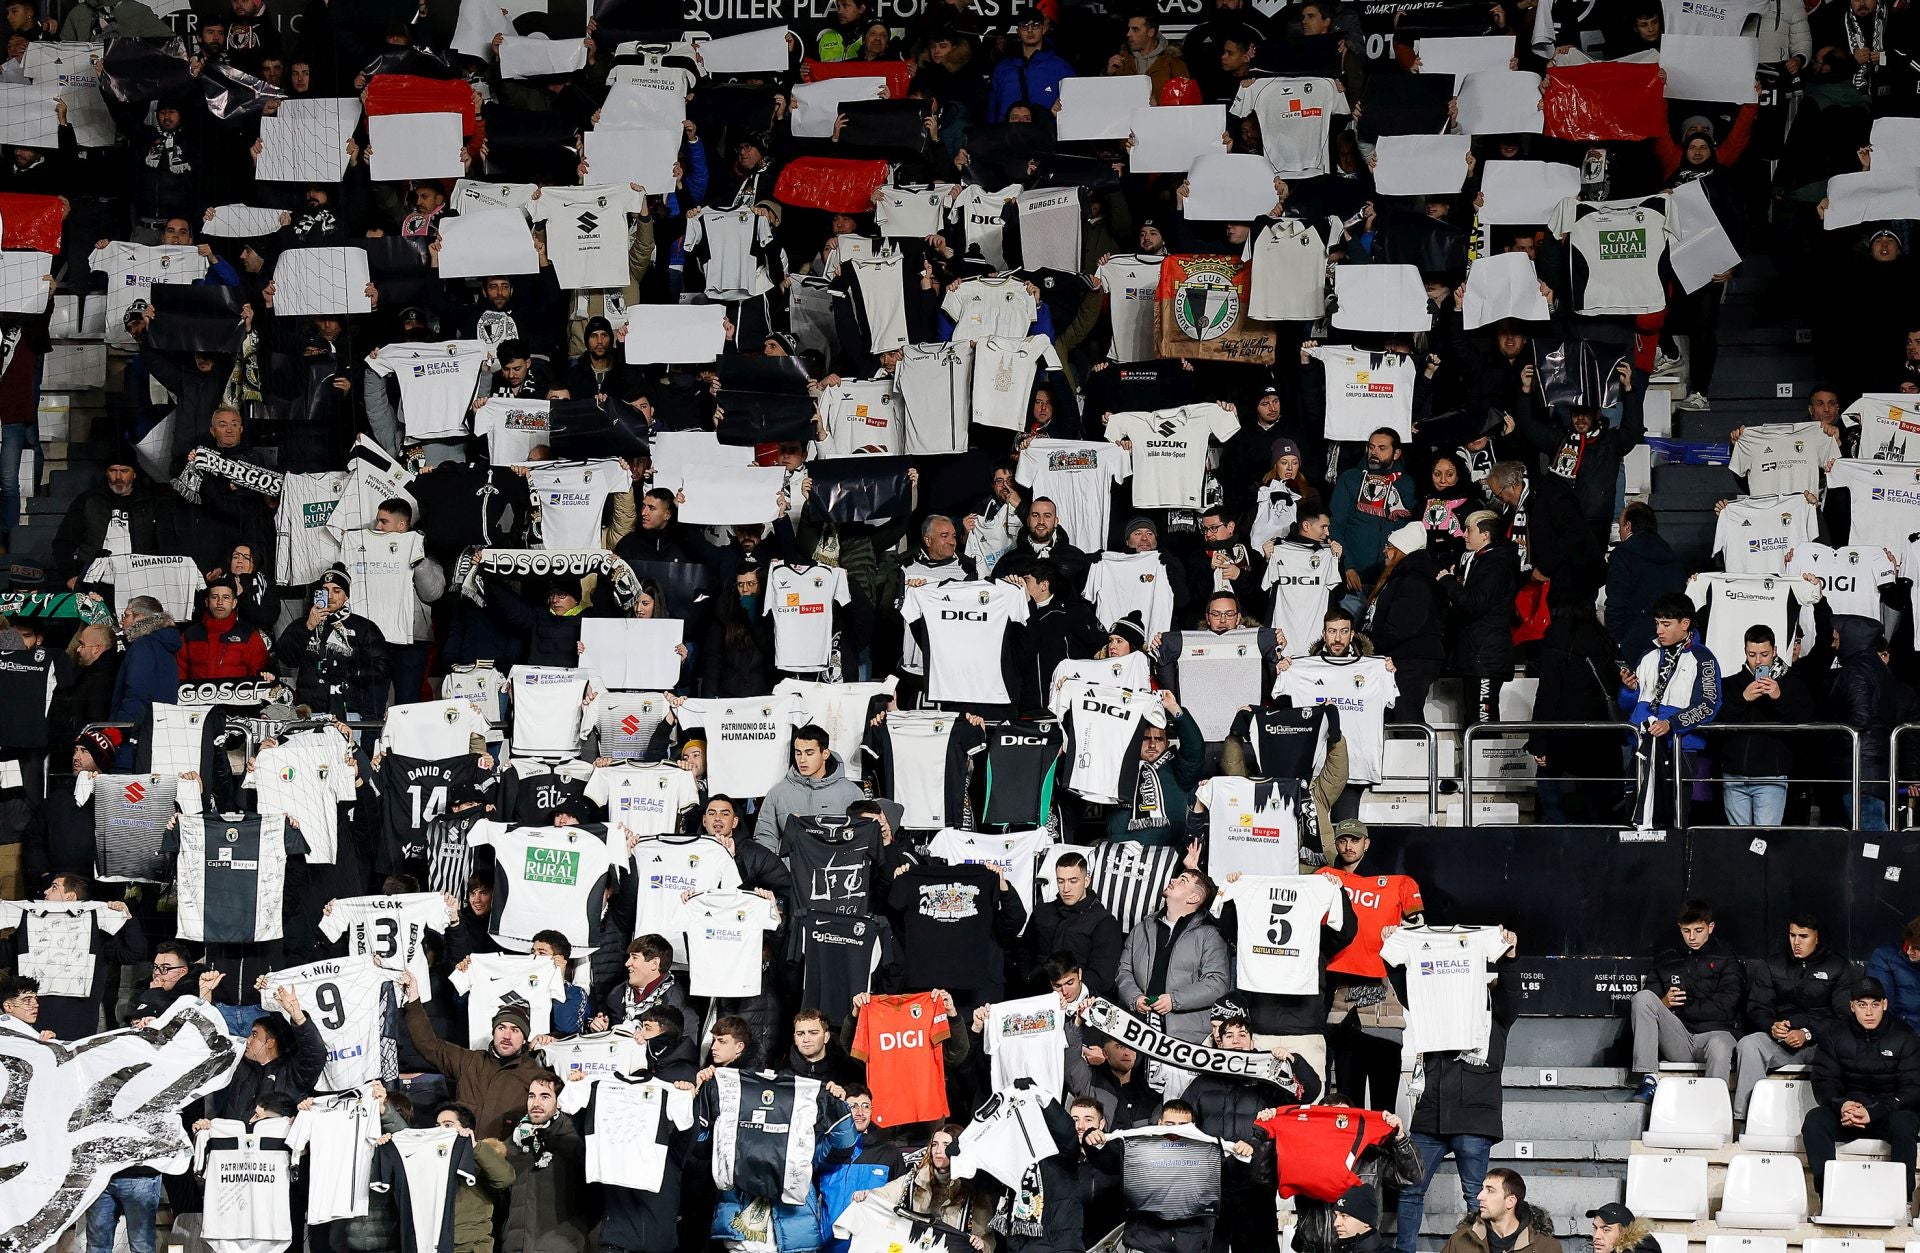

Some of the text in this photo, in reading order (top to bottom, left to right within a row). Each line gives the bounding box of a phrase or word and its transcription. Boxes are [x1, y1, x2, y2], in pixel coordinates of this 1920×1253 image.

[1695, 4, 1727, 16] REALE
[1029, 200, 1055, 211] BURGOS
[1606, 230, 1638, 242] CAJA
[1600, 242, 1646, 255] RURAL
[1196, 274, 1222, 286] CLUB
[1175, 291, 1189, 331] BURGOS
[1217, 297, 1239, 333] FUTBOL
[427, 360, 460, 370] REALE
[428, 367, 460, 377] SEGUROS
[1779, 387, 1791, 395] 15
[867, 418, 886, 428] Burgos
[1876, 417, 1890, 426] Caja
[1901, 422, 1920, 433] Burgo
[1146, 440, 1188, 449] SUZUKI
[205, 450, 283, 493] BURGOS
[562, 493, 591, 501] REALE
[309, 502, 334, 513] CAJA
[1761, 536, 1788, 546] REALE
[132, 556, 184, 568] HUMANIDAD
[370, 561, 400, 569] REALE
[1278, 575, 1320, 586] DIGI
[1737, 592, 1775, 601] Automotive
[800, 605, 822, 614] Burgos
[941, 610, 988, 622] DIGI
[1082, 699, 1132, 721] DIGI
[721, 722, 777, 731] PATRIMONIO DE LA
[1276, 724, 1313, 735] Automotive
[721, 732, 777, 741] HUMANIDAD
[1000, 734, 1049, 747] DIGI
[407, 765, 453, 783] DAVID G.
[406, 784, 449, 829] 14
[633, 797, 665, 808] REALE
[632, 805, 664, 814] SEGUROS
[1228, 826, 1242, 834] Caja
[1254, 828, 1278, 837] Burgos
[1245, 836, 1263, 844] BANCA
[534, 848, 573, 865] CAJA
[233, 861, 255, 869] Burgos
[526, 861, 573, 879] RURAL
[664, 875, 697, 886] REALE
[1269, 887, 1298, 903] LUCIO
[372, 900, 404, 911] LEAK
[1266, 903, 1294, 945] 5
[375, 917, 399, 960] 3
[716, 929, 742, 938] REALE
[824, 932, 865, 946] Automotive
[1435, 959, 1470, 968] REALE
[301, 962, 341, 981] F. NIÑO
[1436, 967, 1470, 975] SEGUROS
[1533, 972, 1546, 980] DEL
[1625, 974, 1638, 982] DEL
[1528, 981, 1541, 991] 85
[1596, 983, 1639, 993] 87 AL 103
[315, 982, 347, 1031] 9
[879, 1029, 924, 1052] DIGI
[584, 1062, 618, 1072] REALE
[1546, 1073, 1553, 1082] 6
[740, 1122, 753, 1131] Caja
[1521, 1146, 1528, 1155] 5
[220, 1162, 277, 1173] PATRIMONIO DE LA
[220, 1173, 277, 1184] HUMANIDAD
